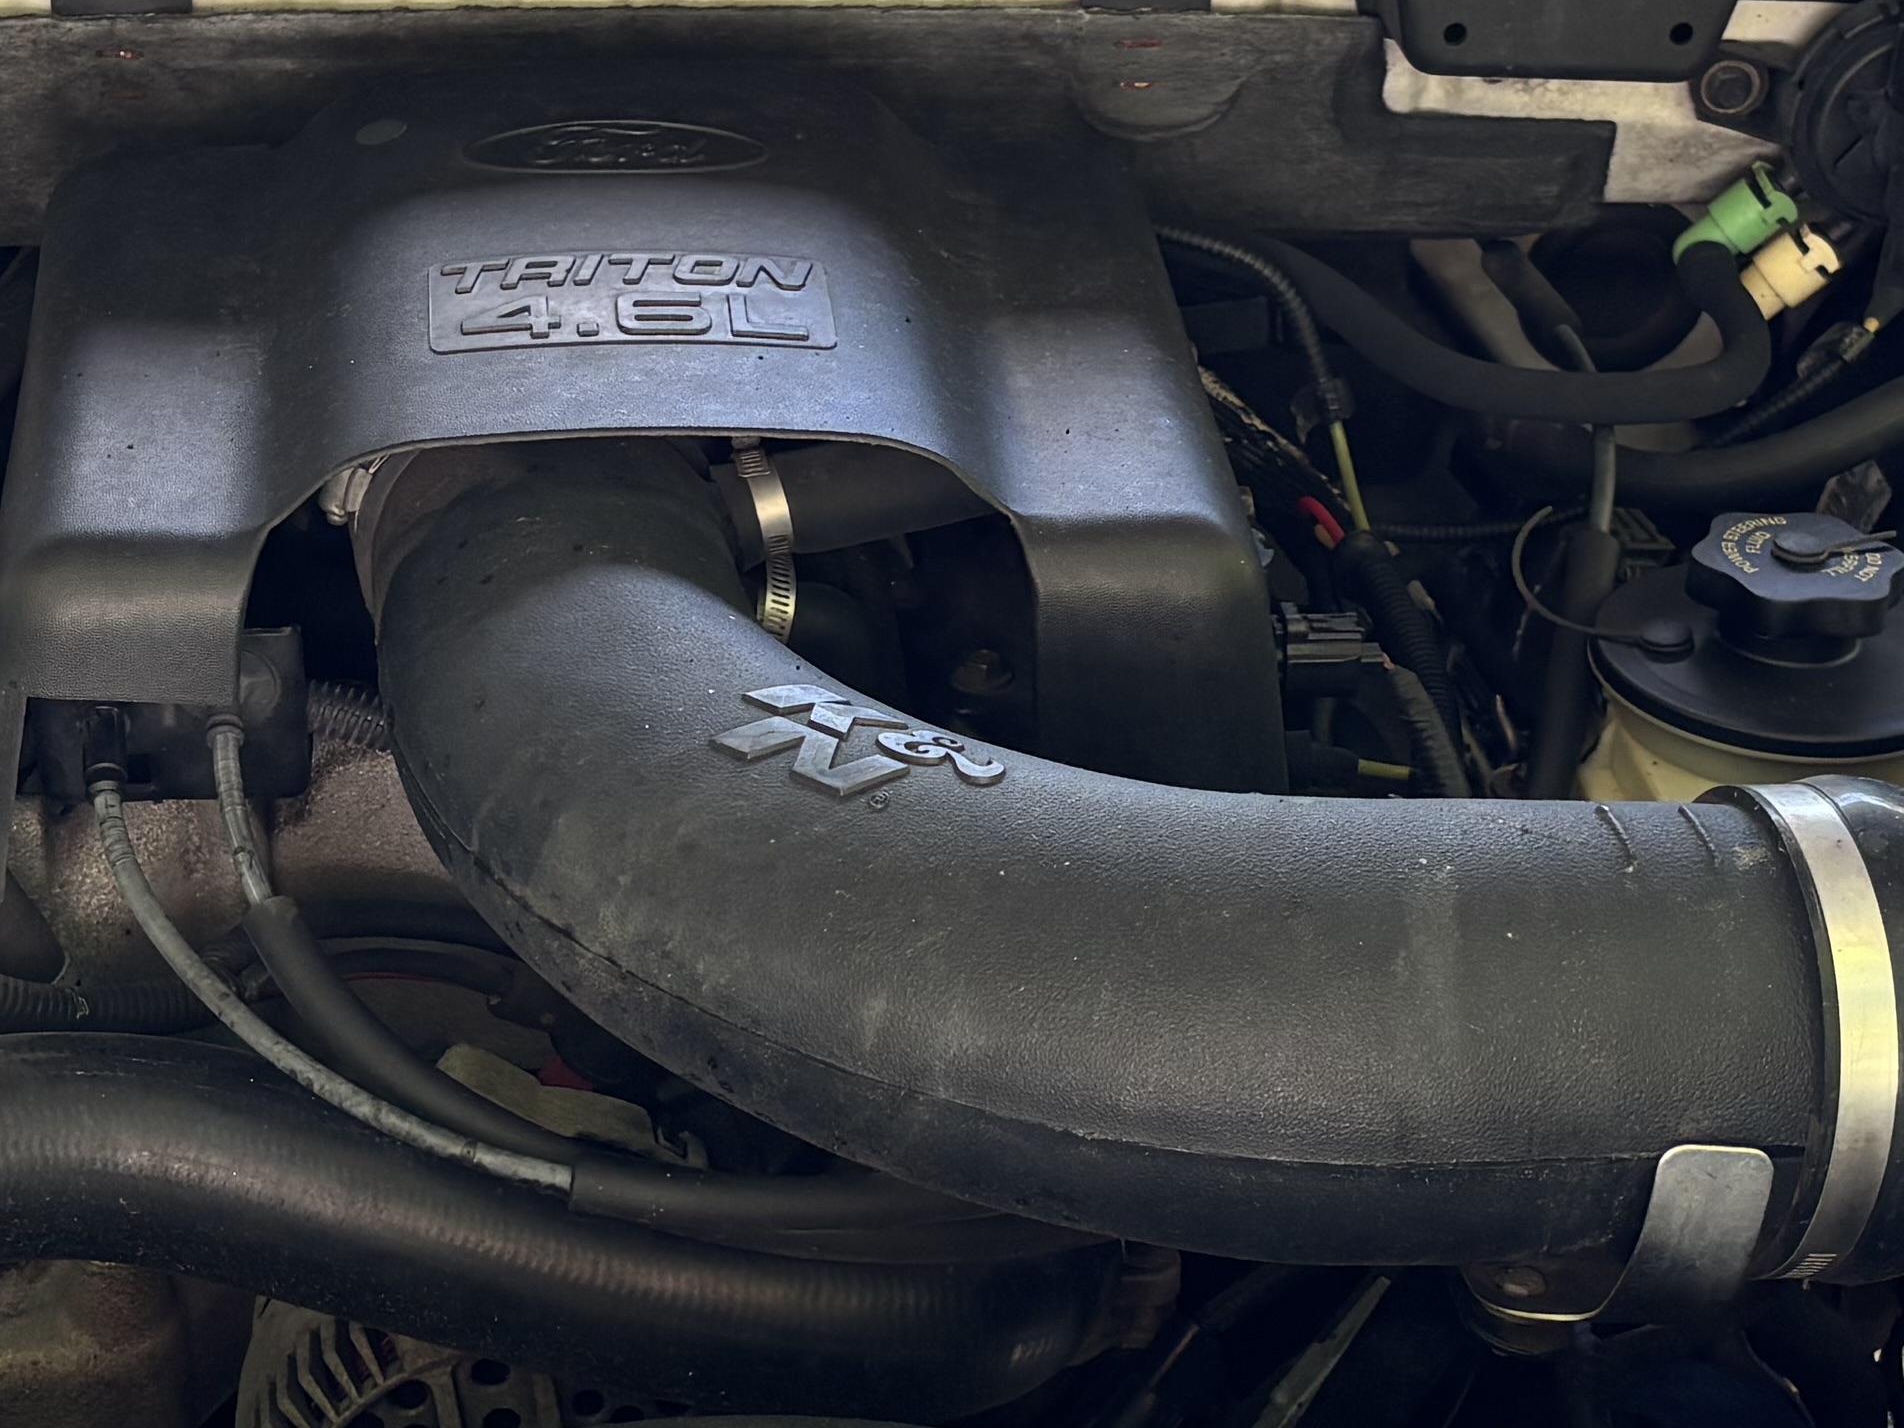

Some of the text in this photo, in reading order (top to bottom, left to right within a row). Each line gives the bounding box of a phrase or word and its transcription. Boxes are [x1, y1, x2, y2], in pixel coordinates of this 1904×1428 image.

[440, 253, 814, 292] TRITON
[460, 292, 810, 340] 4.6L
[1721, 516, 1787, 573] POWER STEERING
[1745, 531, 1771, 554] FLUID
[1854, 552, 1883, 582] DO NOT
